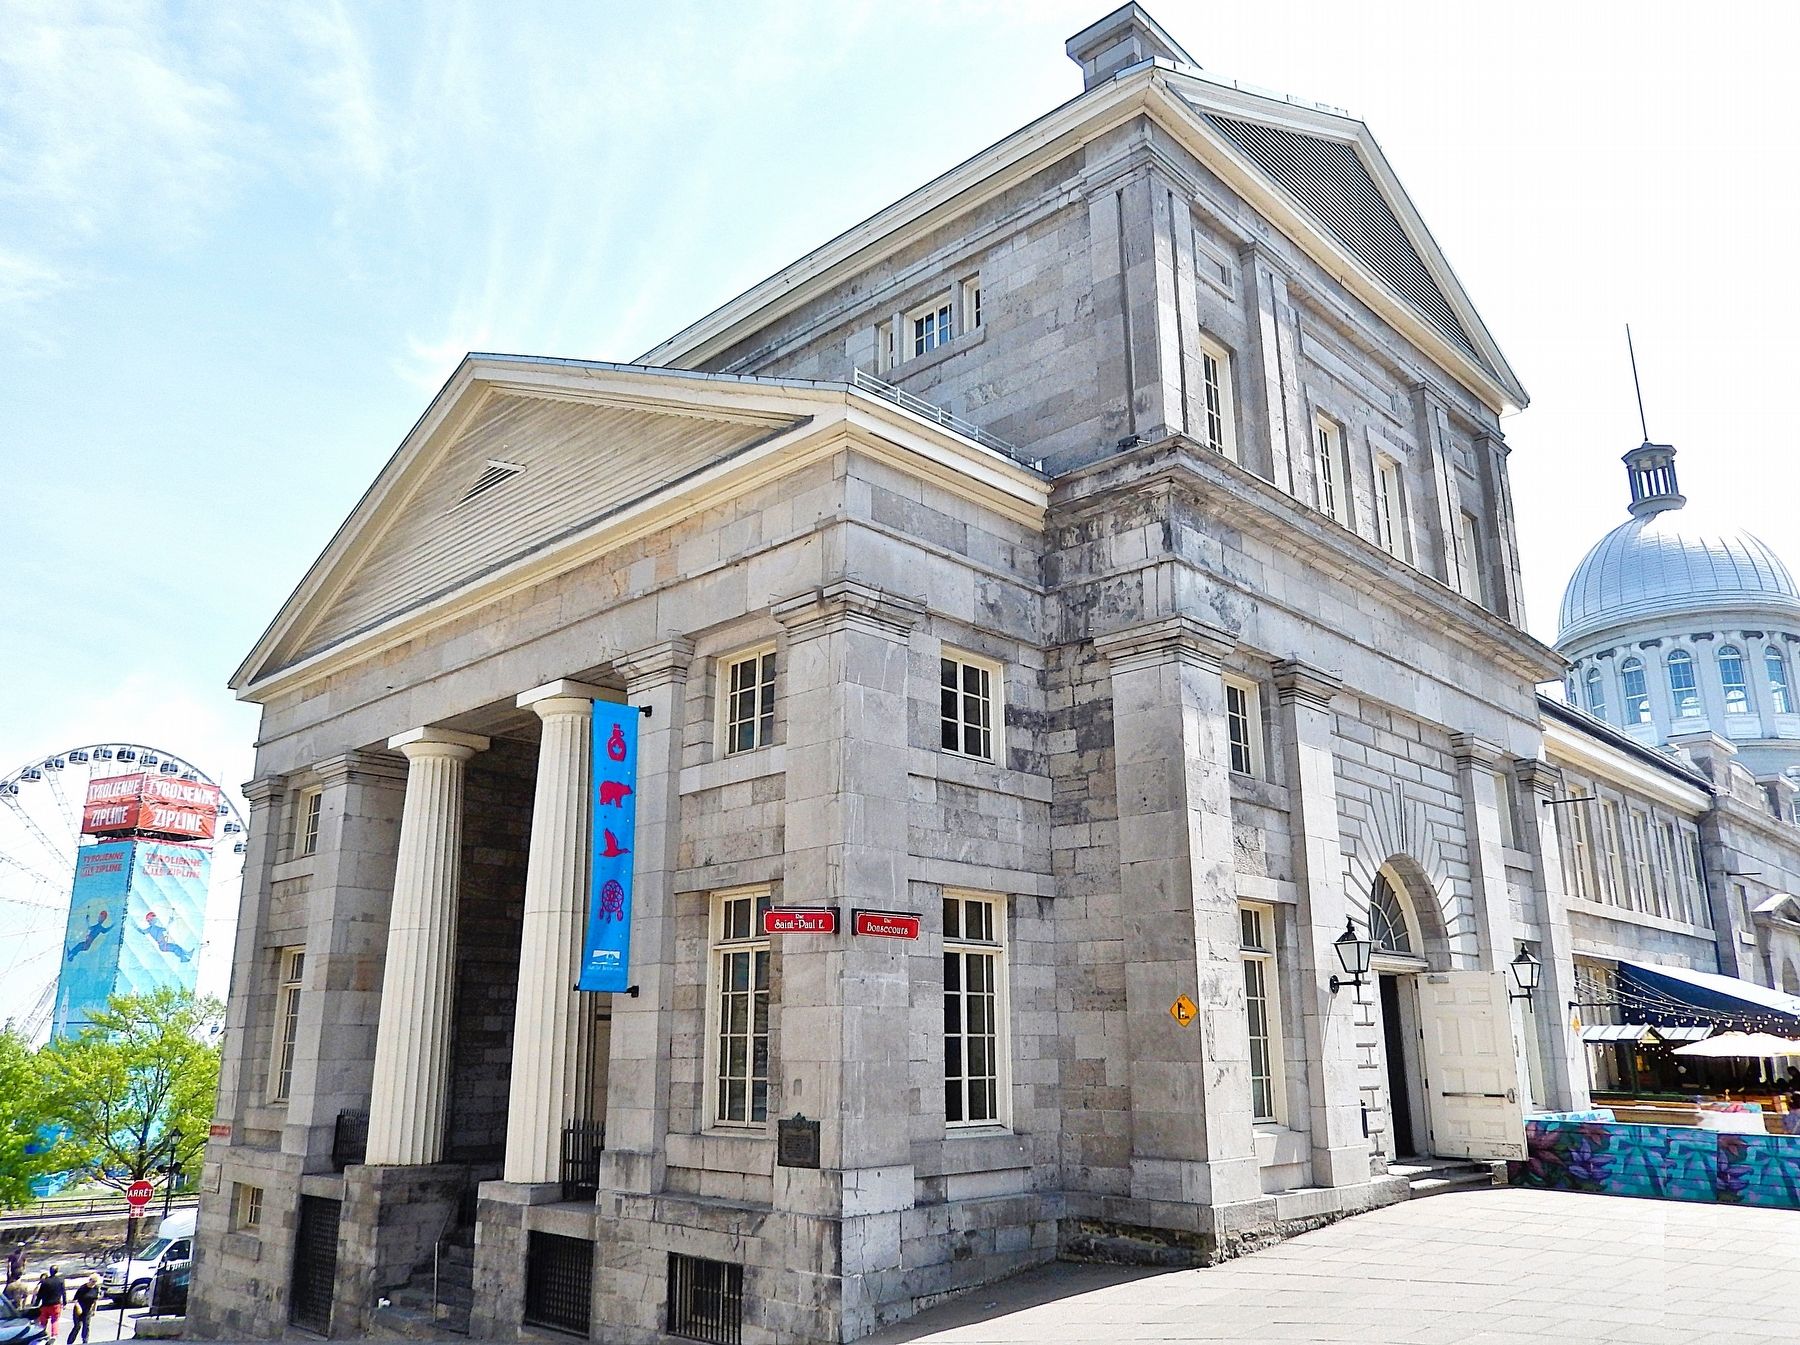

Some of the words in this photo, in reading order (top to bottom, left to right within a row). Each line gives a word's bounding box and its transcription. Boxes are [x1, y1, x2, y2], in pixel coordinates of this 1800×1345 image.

[89, 779, 140, 800] TYROLIENNE
[148, 779, 217, 803] TYROLIENNE
[91, 806, 128, 827] ZIPLINE
[153, 809, 203, 831] ZIPLINE
[774, 919, 815, 929] Saint-Paul
[867, 921, 908, 935] Bonsecours
[128, 1188, 152, 1197] ARRÊT
